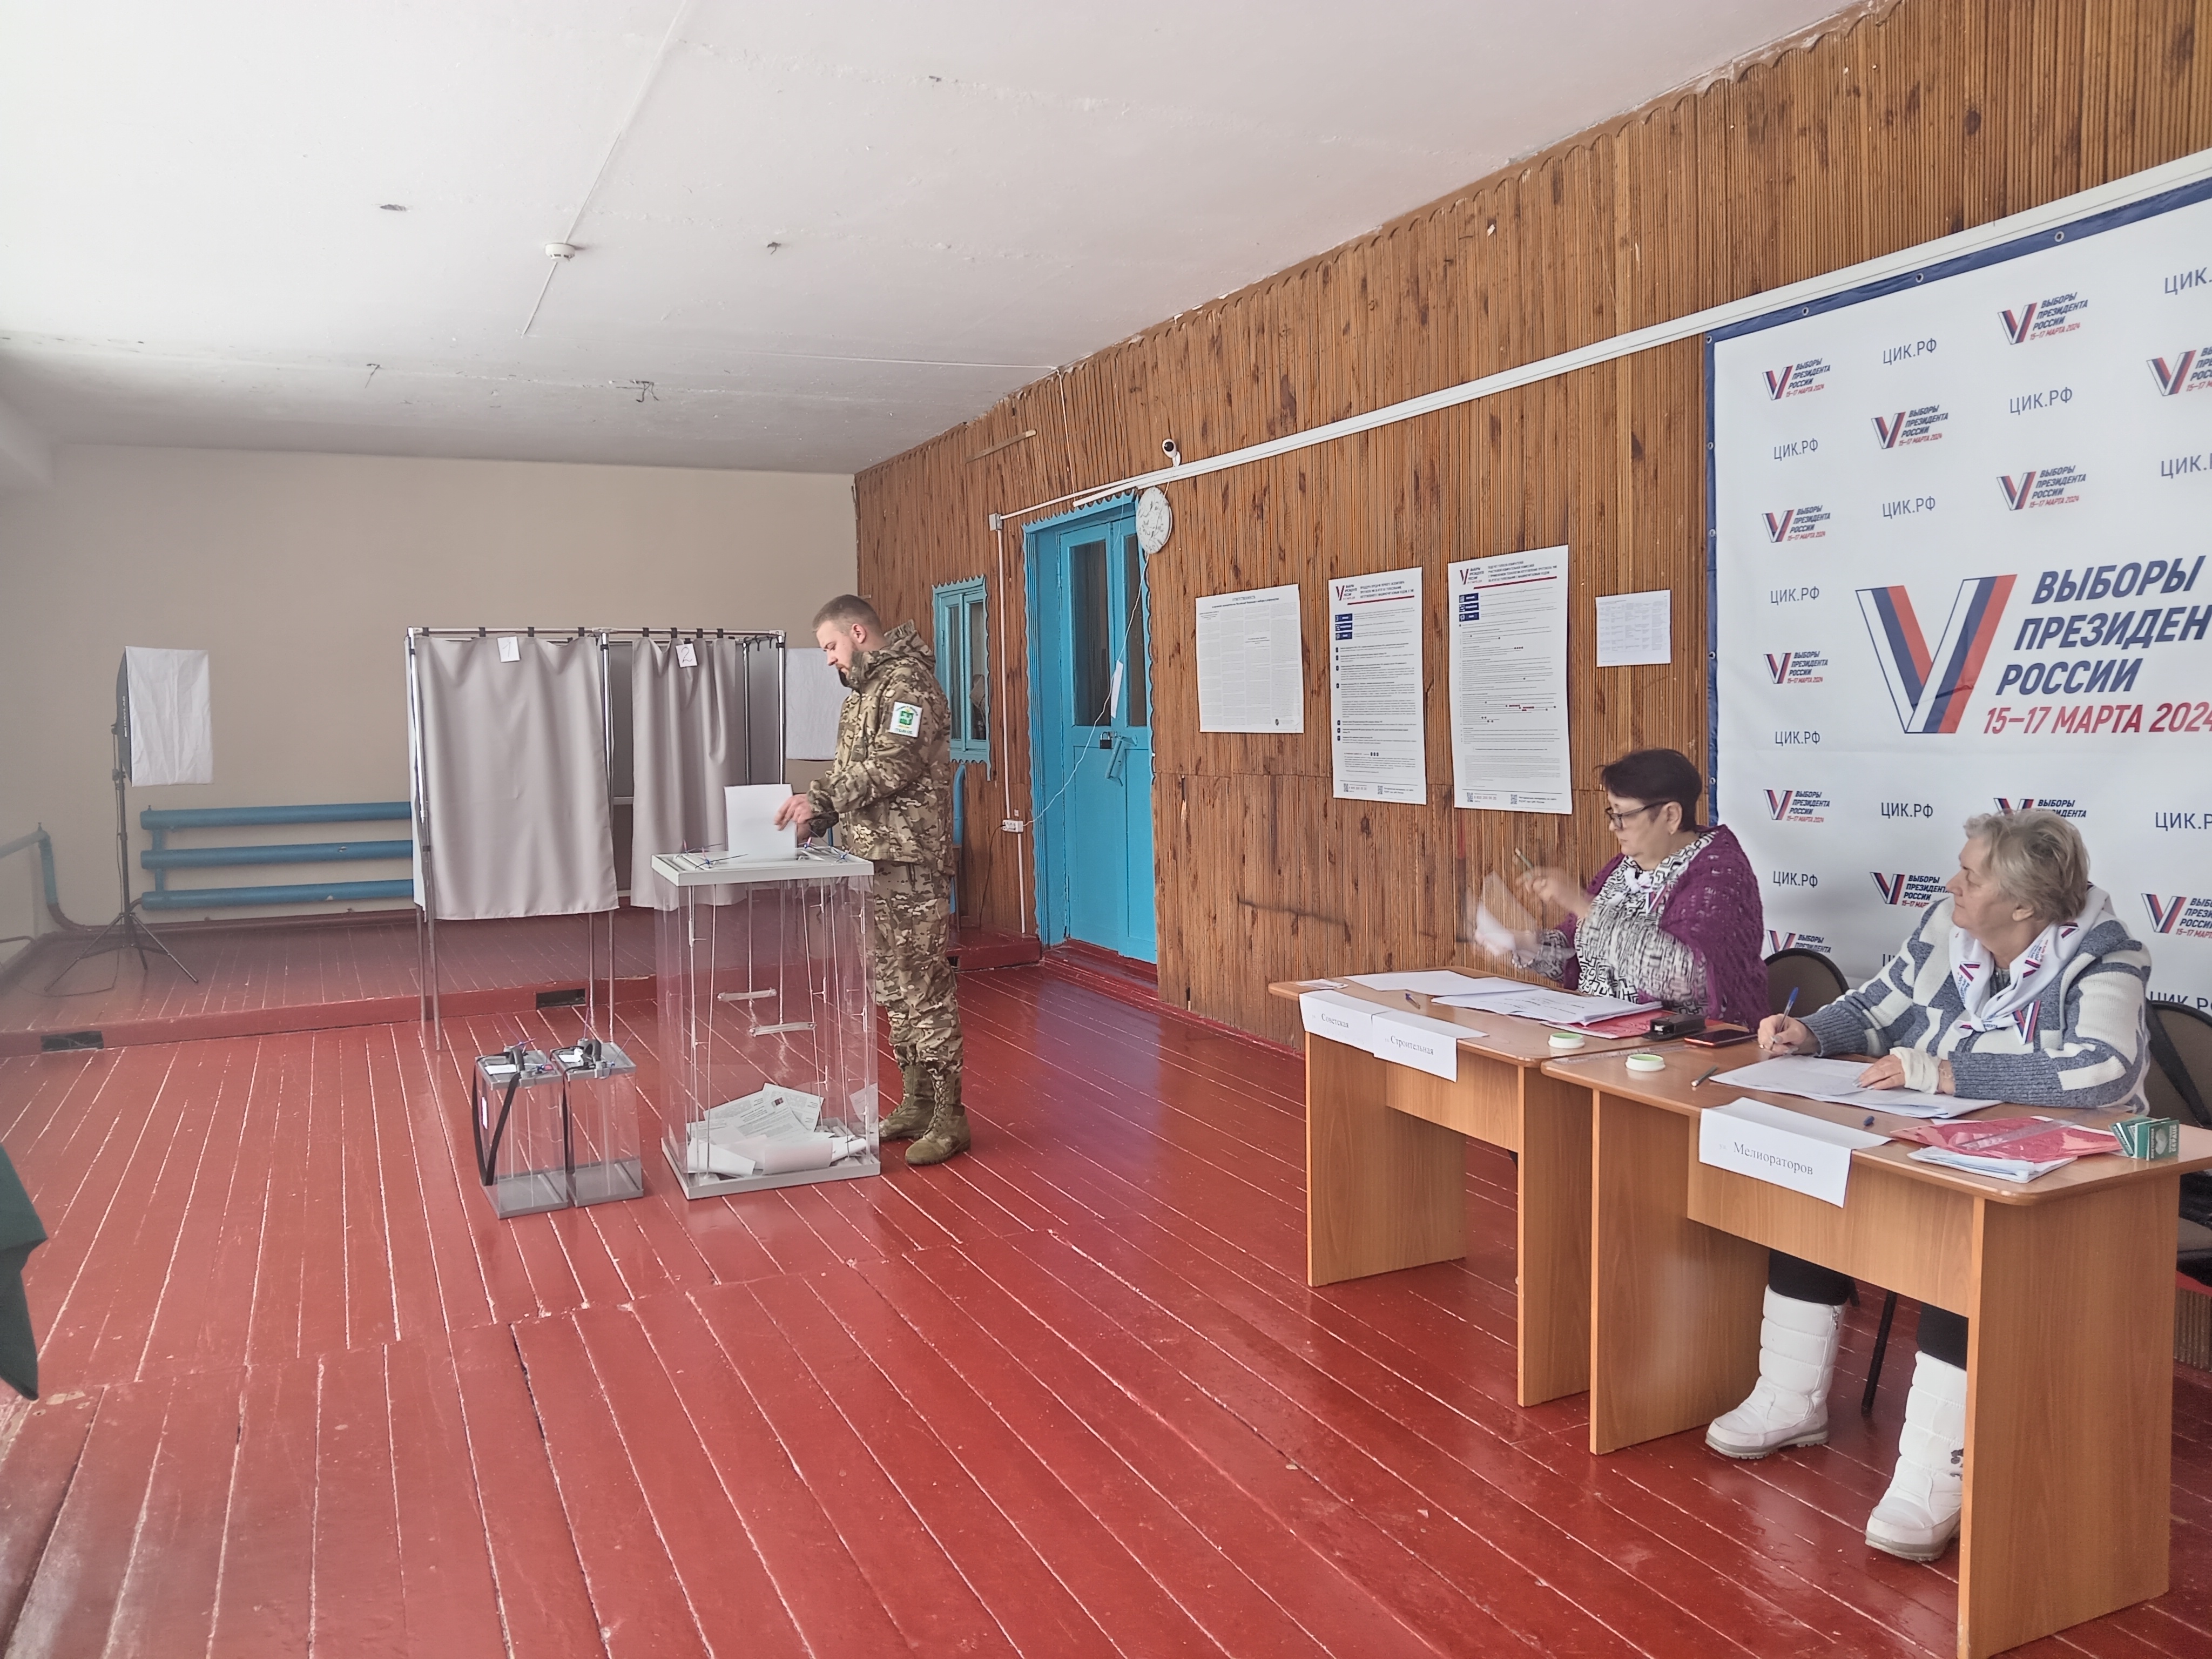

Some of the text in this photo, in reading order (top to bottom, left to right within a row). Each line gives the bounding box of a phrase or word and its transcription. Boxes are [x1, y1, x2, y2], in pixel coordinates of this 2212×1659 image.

[2041, 292, 2078, 308] ВЫБОРЫ
[2036, 300, 2088, 319] ПРЕЗИДЕНТА
[2033, 316, 2066, 331] РОССИИ
[1883, 338, 1937, 365] ЦИК.РФ
[1788, 377, 1814, 389] РОССИИ
[2010, 387, 2072, 415] ЦИК.РФ
[1908, 404, 1939, 417] ВЫБОРЫ
[1905, 413, 1948, 428] ПРЕЗИДЕНТА
[1901, 426, 1930, 437] РОССИИ
[1774, 438, 1818, 461] ЦИК.РФ
[2039, 465, 2076, 478] ВЫБОРЫ
[2161, 453, 2212, 479] ЦИК.
[2035, 474, 2086, 488] ПРЕЗИДЕНТА
[2032, 488, 2064, 499] РОССИИ
[1883, 496, 1936, 519] ЦИК.РФ
[2031, 555, 2206, 604] ВЫБОРЫ
[1771, 586, 1819, 605] ЦИК.РФ
[2014, 604, 2212, 650] ПРЕЗИДЕН
[502, 642, 511, 657] 1
[681, 647, 692, 663] 2
[1995, 658, 2143, 696] РОССИИ
[2051, 704, 2143, 734] МАРТА
[1775, 731, 1820, 747] ЦИК.РФ
[1881, 802, 1933, 819] ЦИК.РФ
[1773, 871, 1818, 888] ЦИК.РФ
[1908, 875, 1940, 884] ВЫБОРЫ
[1903, 892, 1932, 901] РОССИИ
[1906, 884, 1950, 893] ПРЕЗИДЕНТ
[1321, 1014, 1348, 1028] Советская
[1391, 1035, 1434, 1055] Строительная
[1734, 1142, 1813, 1175] Мелиораторов
